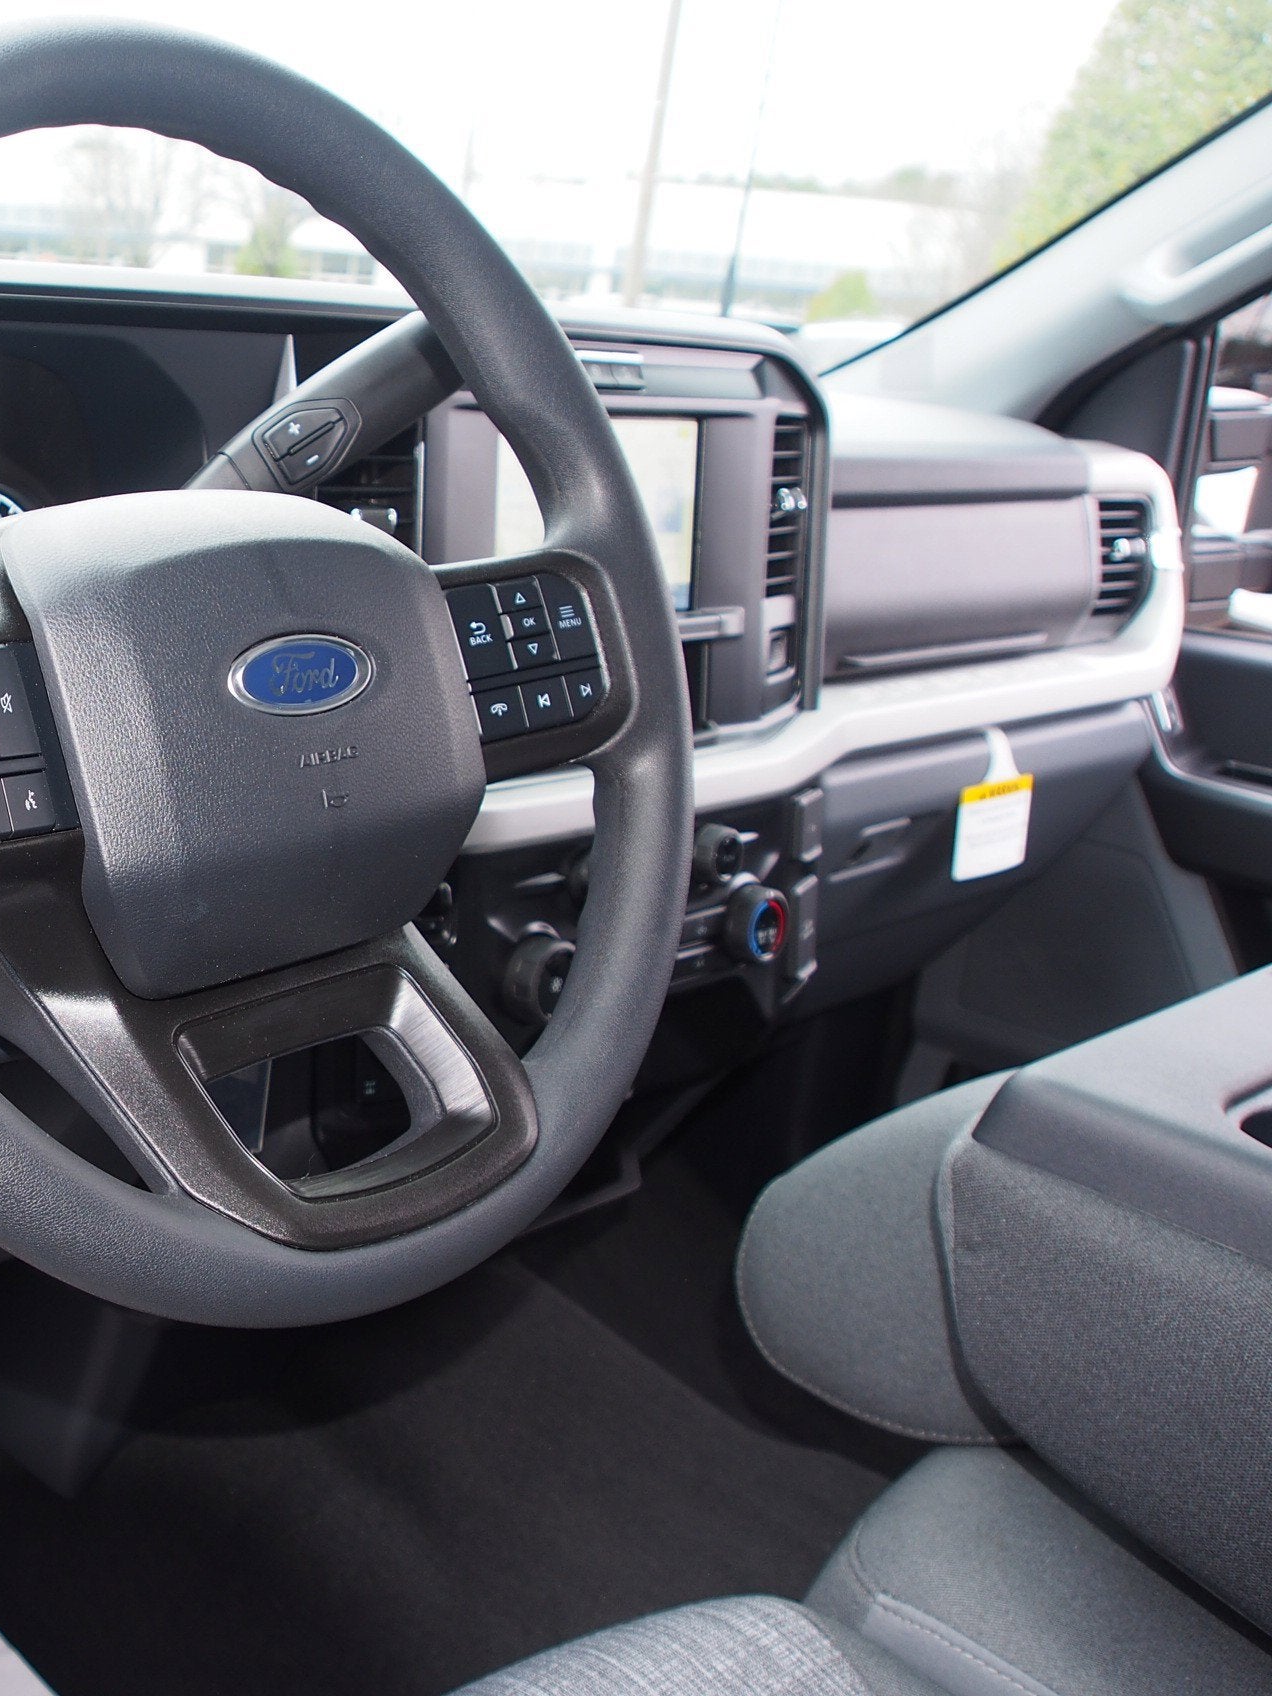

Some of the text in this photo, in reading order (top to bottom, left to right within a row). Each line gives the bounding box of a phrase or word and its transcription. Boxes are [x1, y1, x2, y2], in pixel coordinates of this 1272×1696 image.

[523, 617, 536, 627] OK
[559, 617, 582, 628] MENU
[469, 633, 493, 646] BACK
[271, 651, 338, 696] Ford
